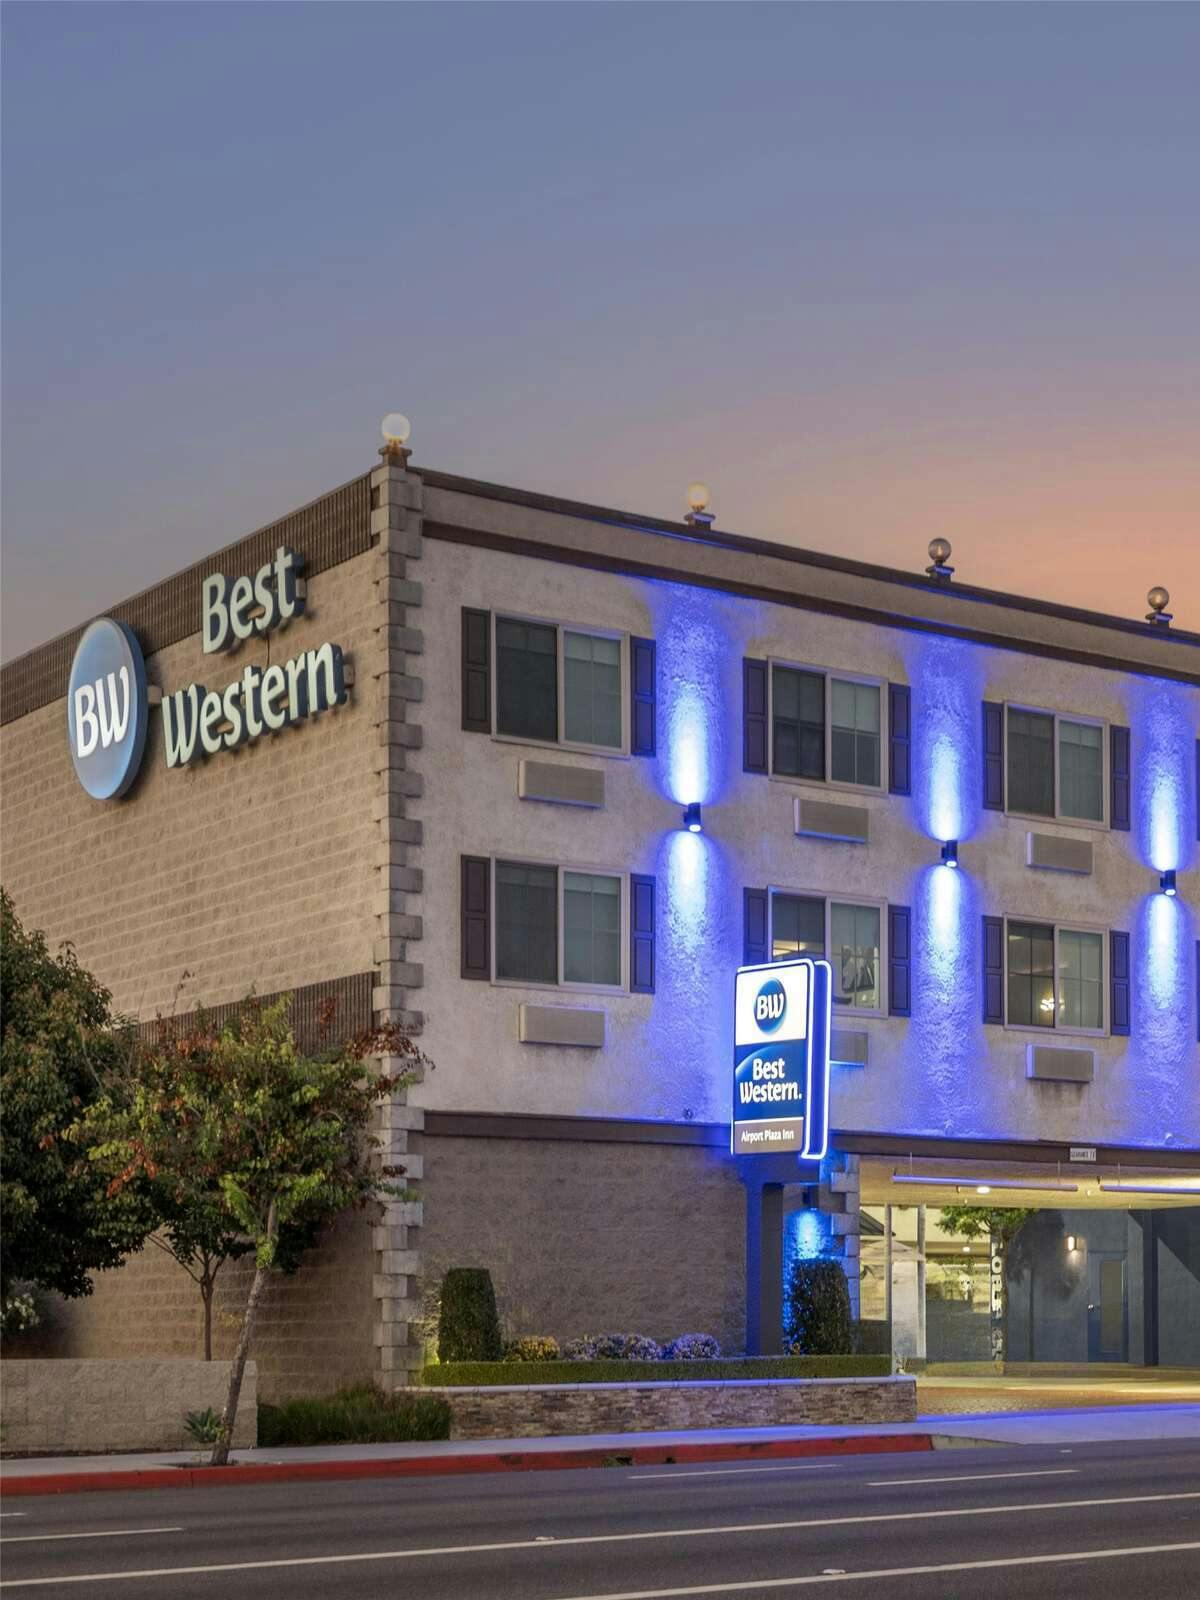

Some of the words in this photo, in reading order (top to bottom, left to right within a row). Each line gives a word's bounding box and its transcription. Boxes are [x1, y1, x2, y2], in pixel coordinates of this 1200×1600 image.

[202, 545, 296, 654] Best
[74, 666, 130, 759] BW
[161, 641, 340, 768] Western
[756, 992, 785, 1020] BW
[753, 1057, 785, 1081] Best
[741, 1130, 764, 1144] Airport
[764, 1129, 782, 1141] Plaza
[782, 1128, 795, 1140] Inn
